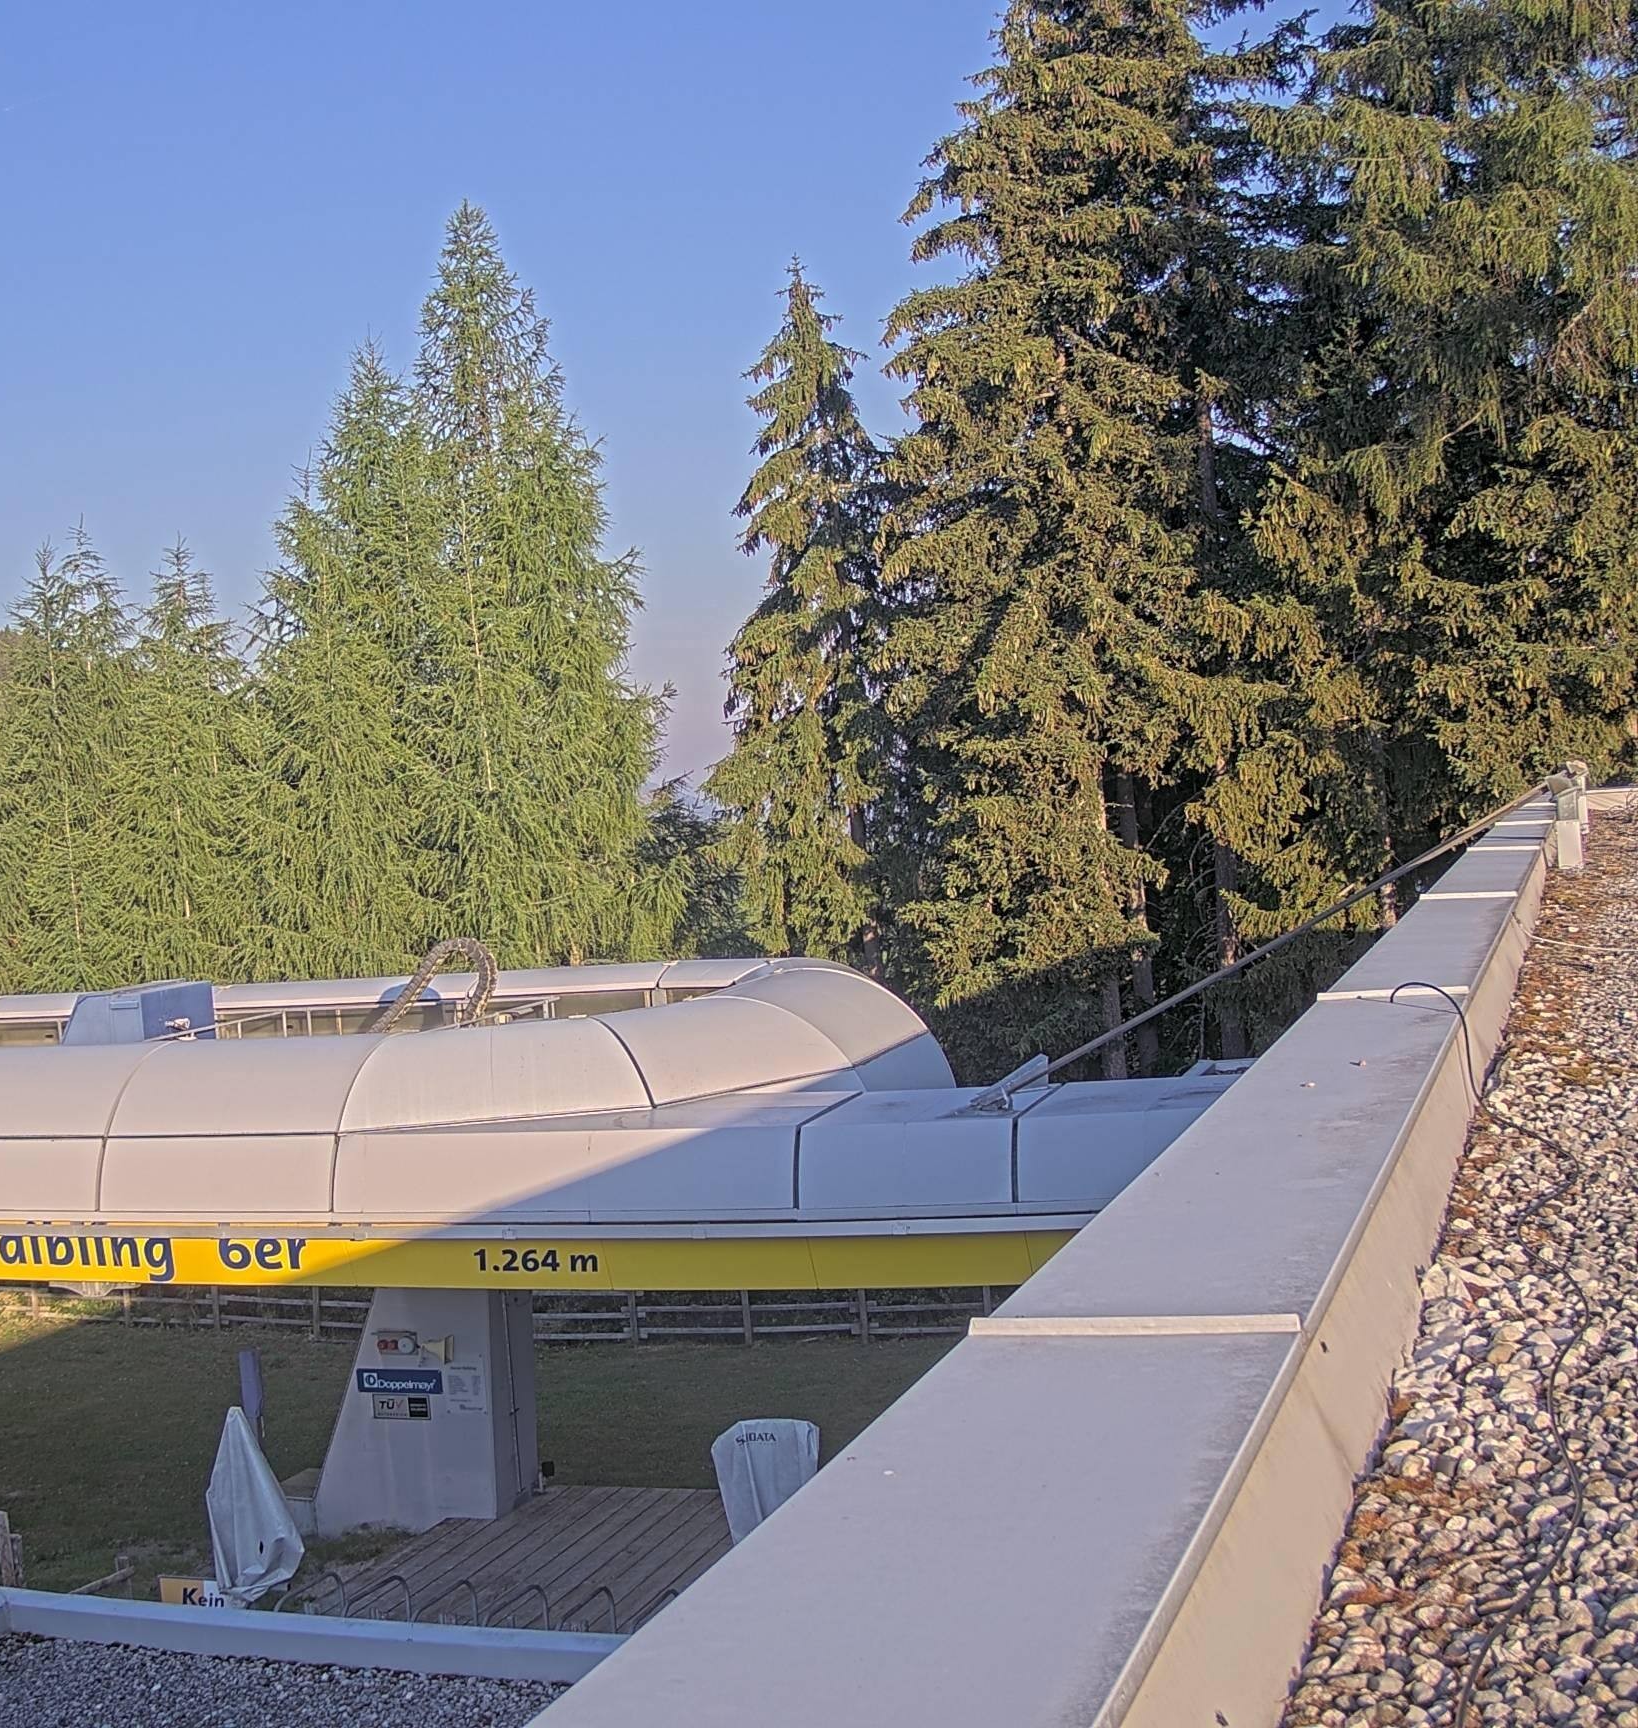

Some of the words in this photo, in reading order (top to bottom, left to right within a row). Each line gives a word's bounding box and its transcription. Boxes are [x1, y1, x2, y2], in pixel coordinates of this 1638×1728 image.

[473, 1248, 560, 1272] 1.264
[570, 1254, 598, 1272] m
[378, 1379, 436, 1392] Doppelmayr
[182, 1587, 225, 1608] Kein
